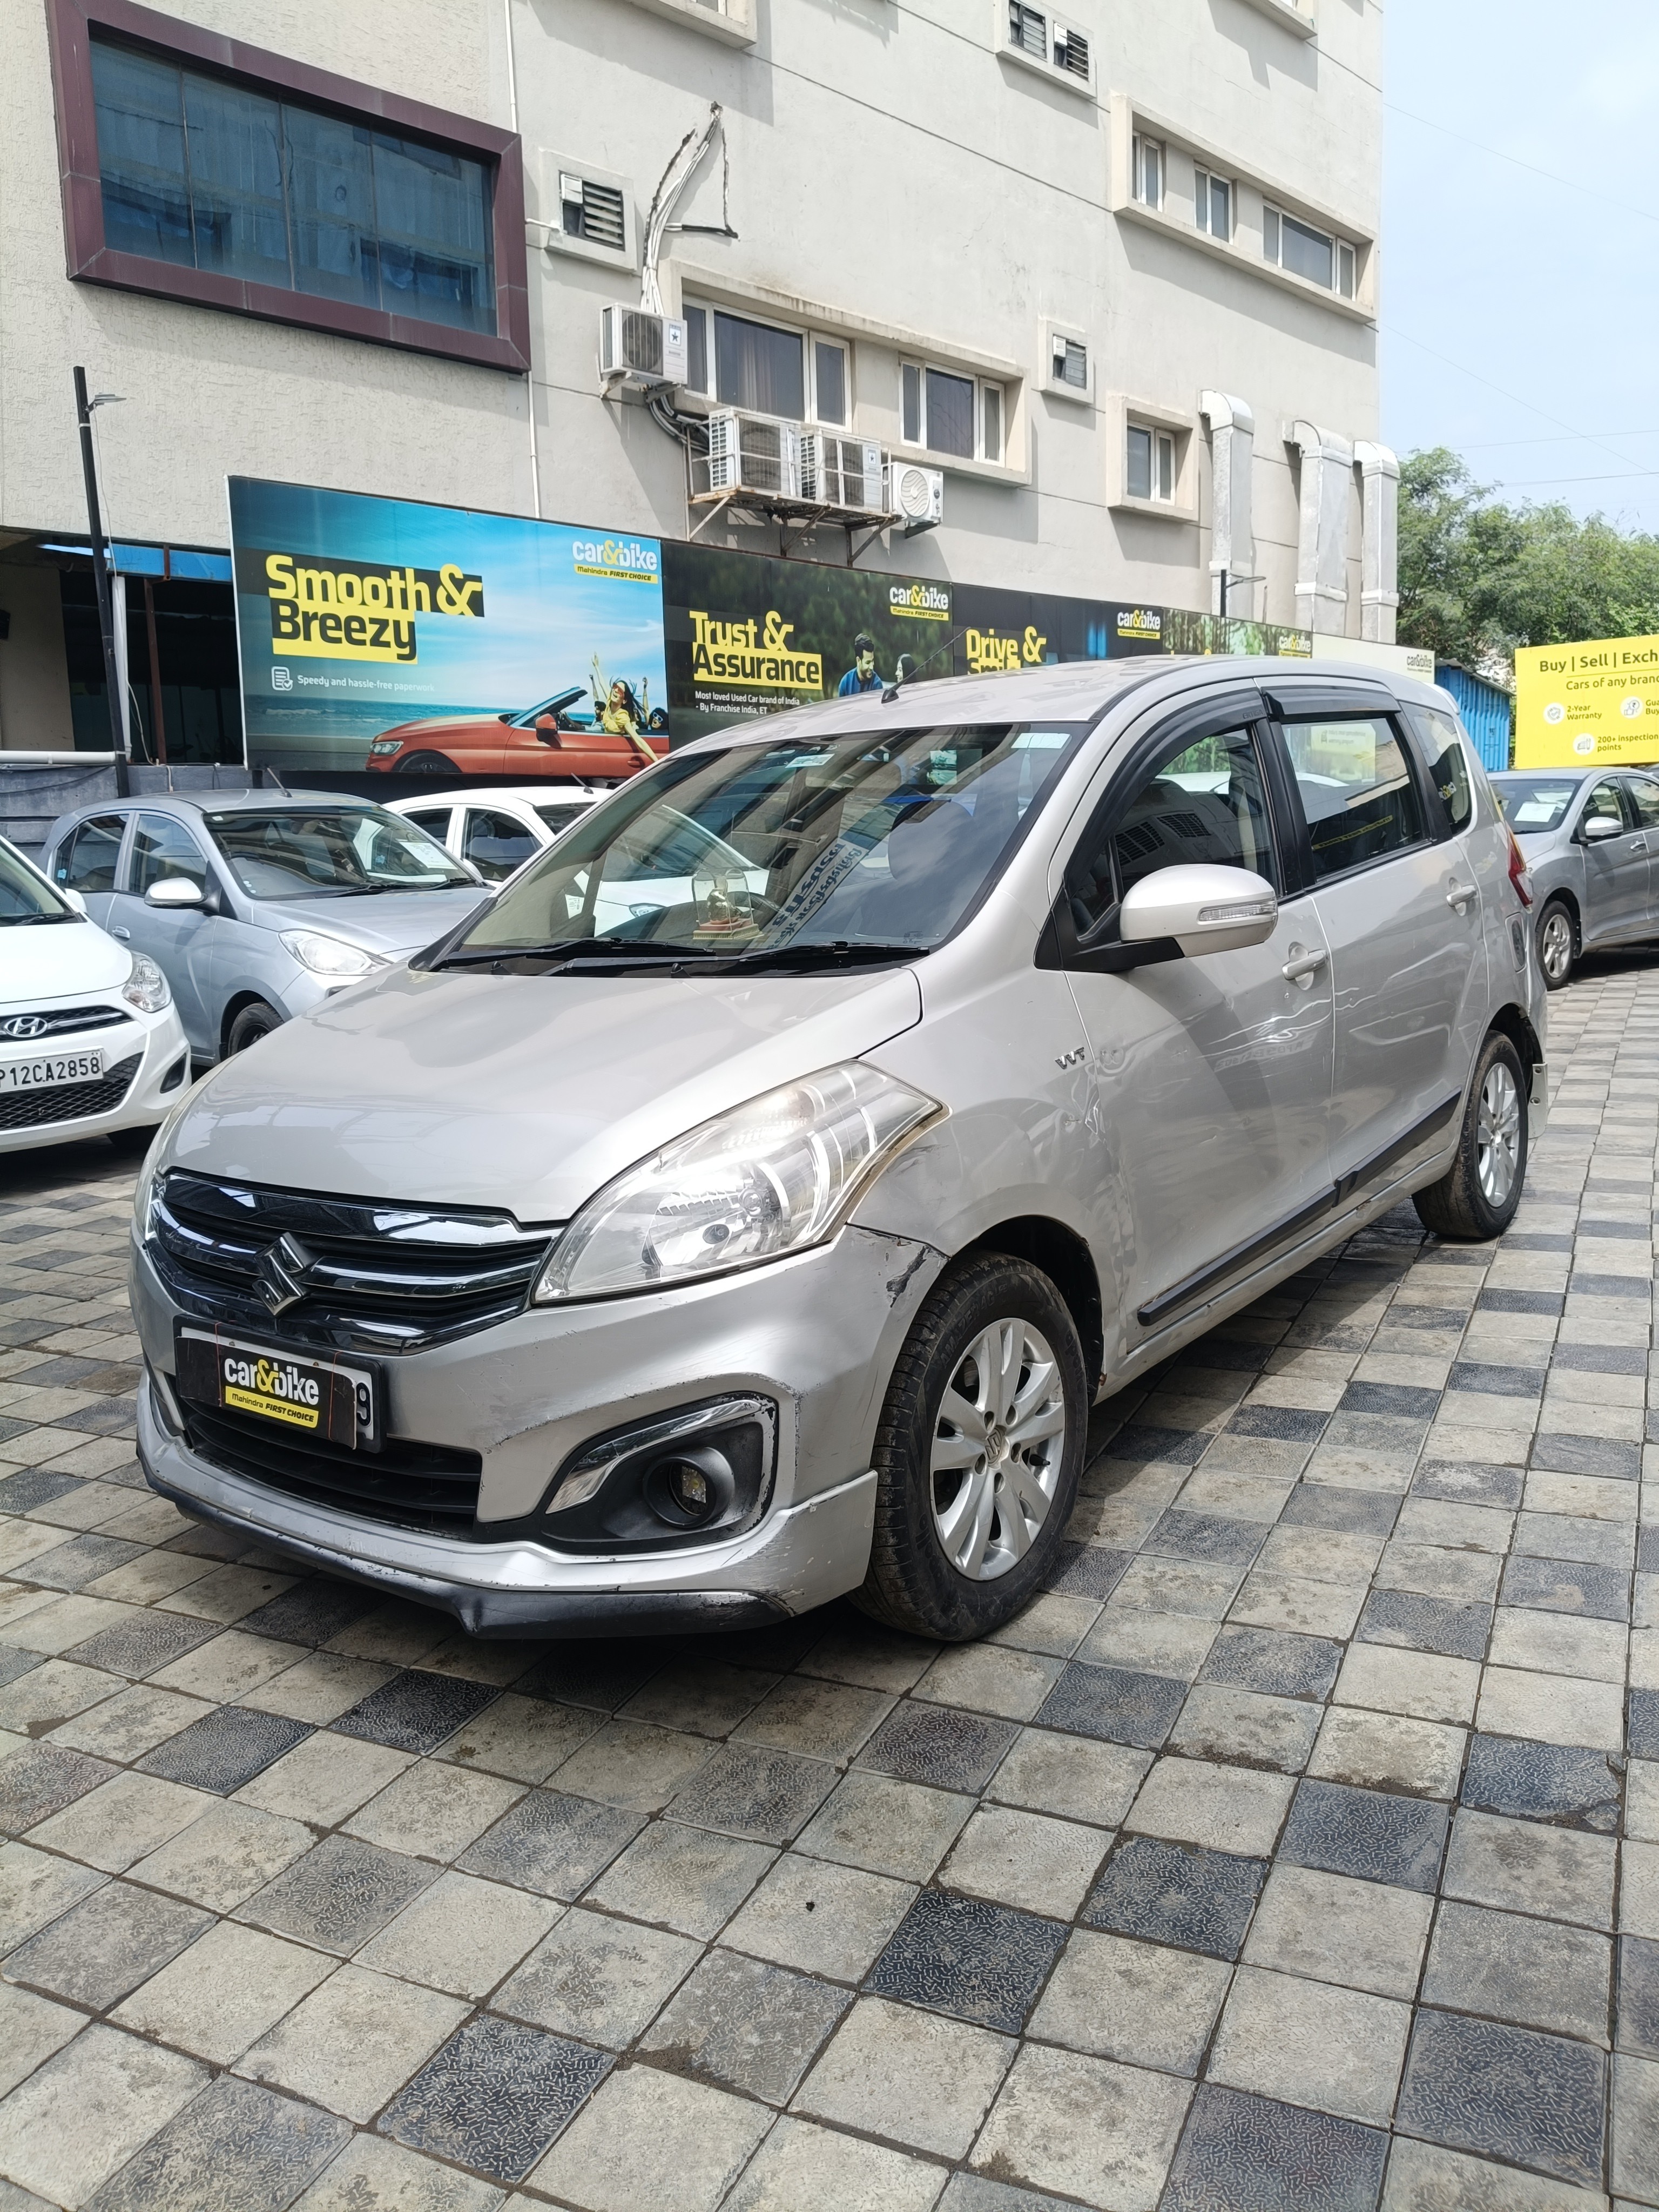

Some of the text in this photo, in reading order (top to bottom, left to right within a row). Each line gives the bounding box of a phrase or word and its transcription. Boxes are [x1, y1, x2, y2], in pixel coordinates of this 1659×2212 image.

[572, 539, 657, 571] car&bike
[265, 554, 483, 617] Smooth &
[577, 566, 608, 576] Mahindra
[629, 573, 651, 581] CHOICE
[889, 584, 949, 610] car&bike
[271, 598, 417, 661] Breezy
[689, 610, 794, 651] Trust &
[1117, 609, 1161, 630] car&bike
[966, 626, 1047, 663] Drive &
[693, 644, 820, 684] Assurance
[1539, 659, 1567, 673] Buy
[1580, 653, 1608, 669] Sell
[1622, 649, 1658, 664] Exch
[297, 675, 435, 692] Speedy and hassle-free paperwork
[1566, 680, 1590, 690] Cars
[1593, 677, 1605, 689] of
[1607, 678, 1627, 688] any
[695, 691, 712, 700] Most
[713, 692, 730, 701] loved
[731, 693, 747, 702] Used
[747, 694, 758, 703] Car
[759, 694, 777, 704] brand
[785, 697, 800, 705] India
[699, 703, 709, 712] By
[710, 703, 740, 713] Franchise
[741, 705, 759, 715] India,
[759, 706, 768, 714] ET
[1597, 744, 1622, 752] points
[1618, 733, 1658, 743] inspection
[224, 1358, 320, 1405] car&bike
[232, 1393, 314, 1422] Mahindra FIRST CHOICE
